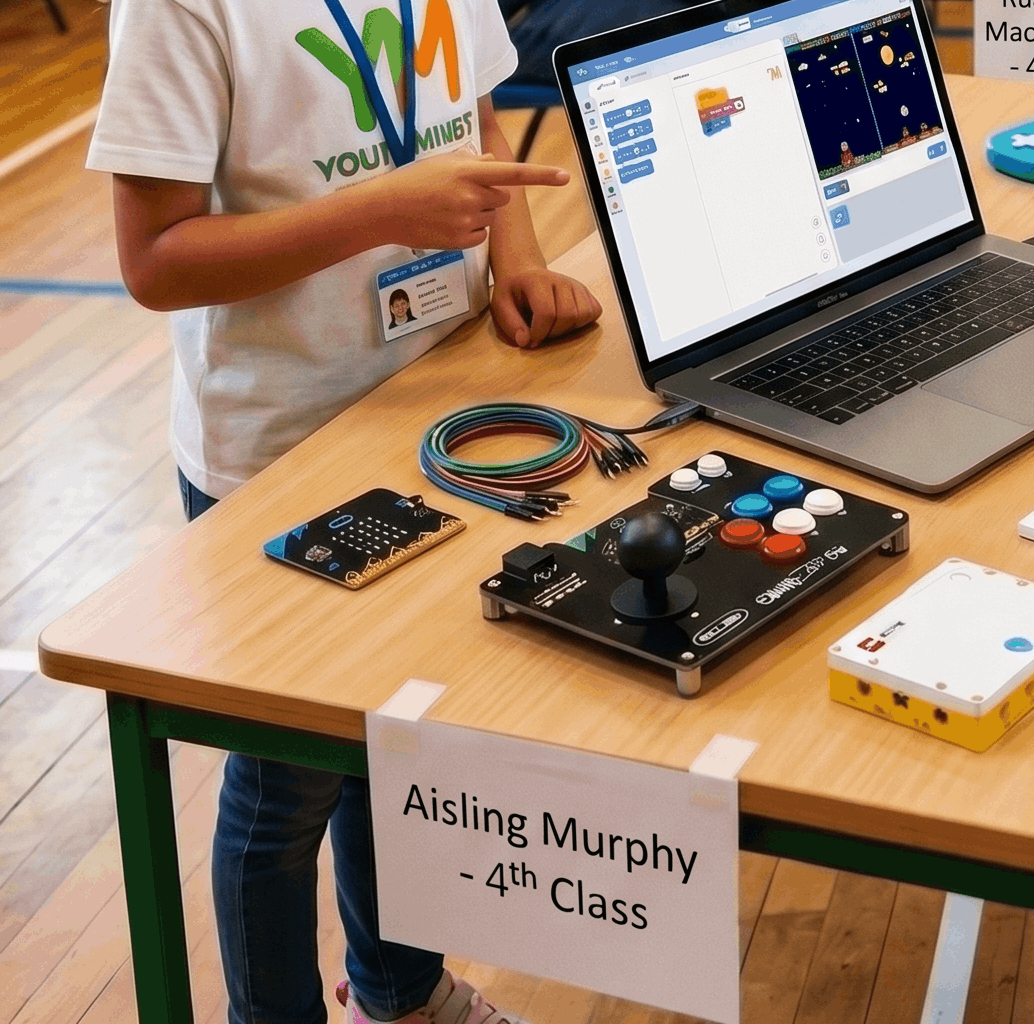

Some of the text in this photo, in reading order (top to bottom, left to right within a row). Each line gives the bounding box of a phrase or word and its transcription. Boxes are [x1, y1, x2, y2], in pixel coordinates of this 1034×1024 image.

[402, 783, 699, 885] Aisling Murphy
[485, 861, 538, 898] 4th
[550, 877, 649, 930] Class
